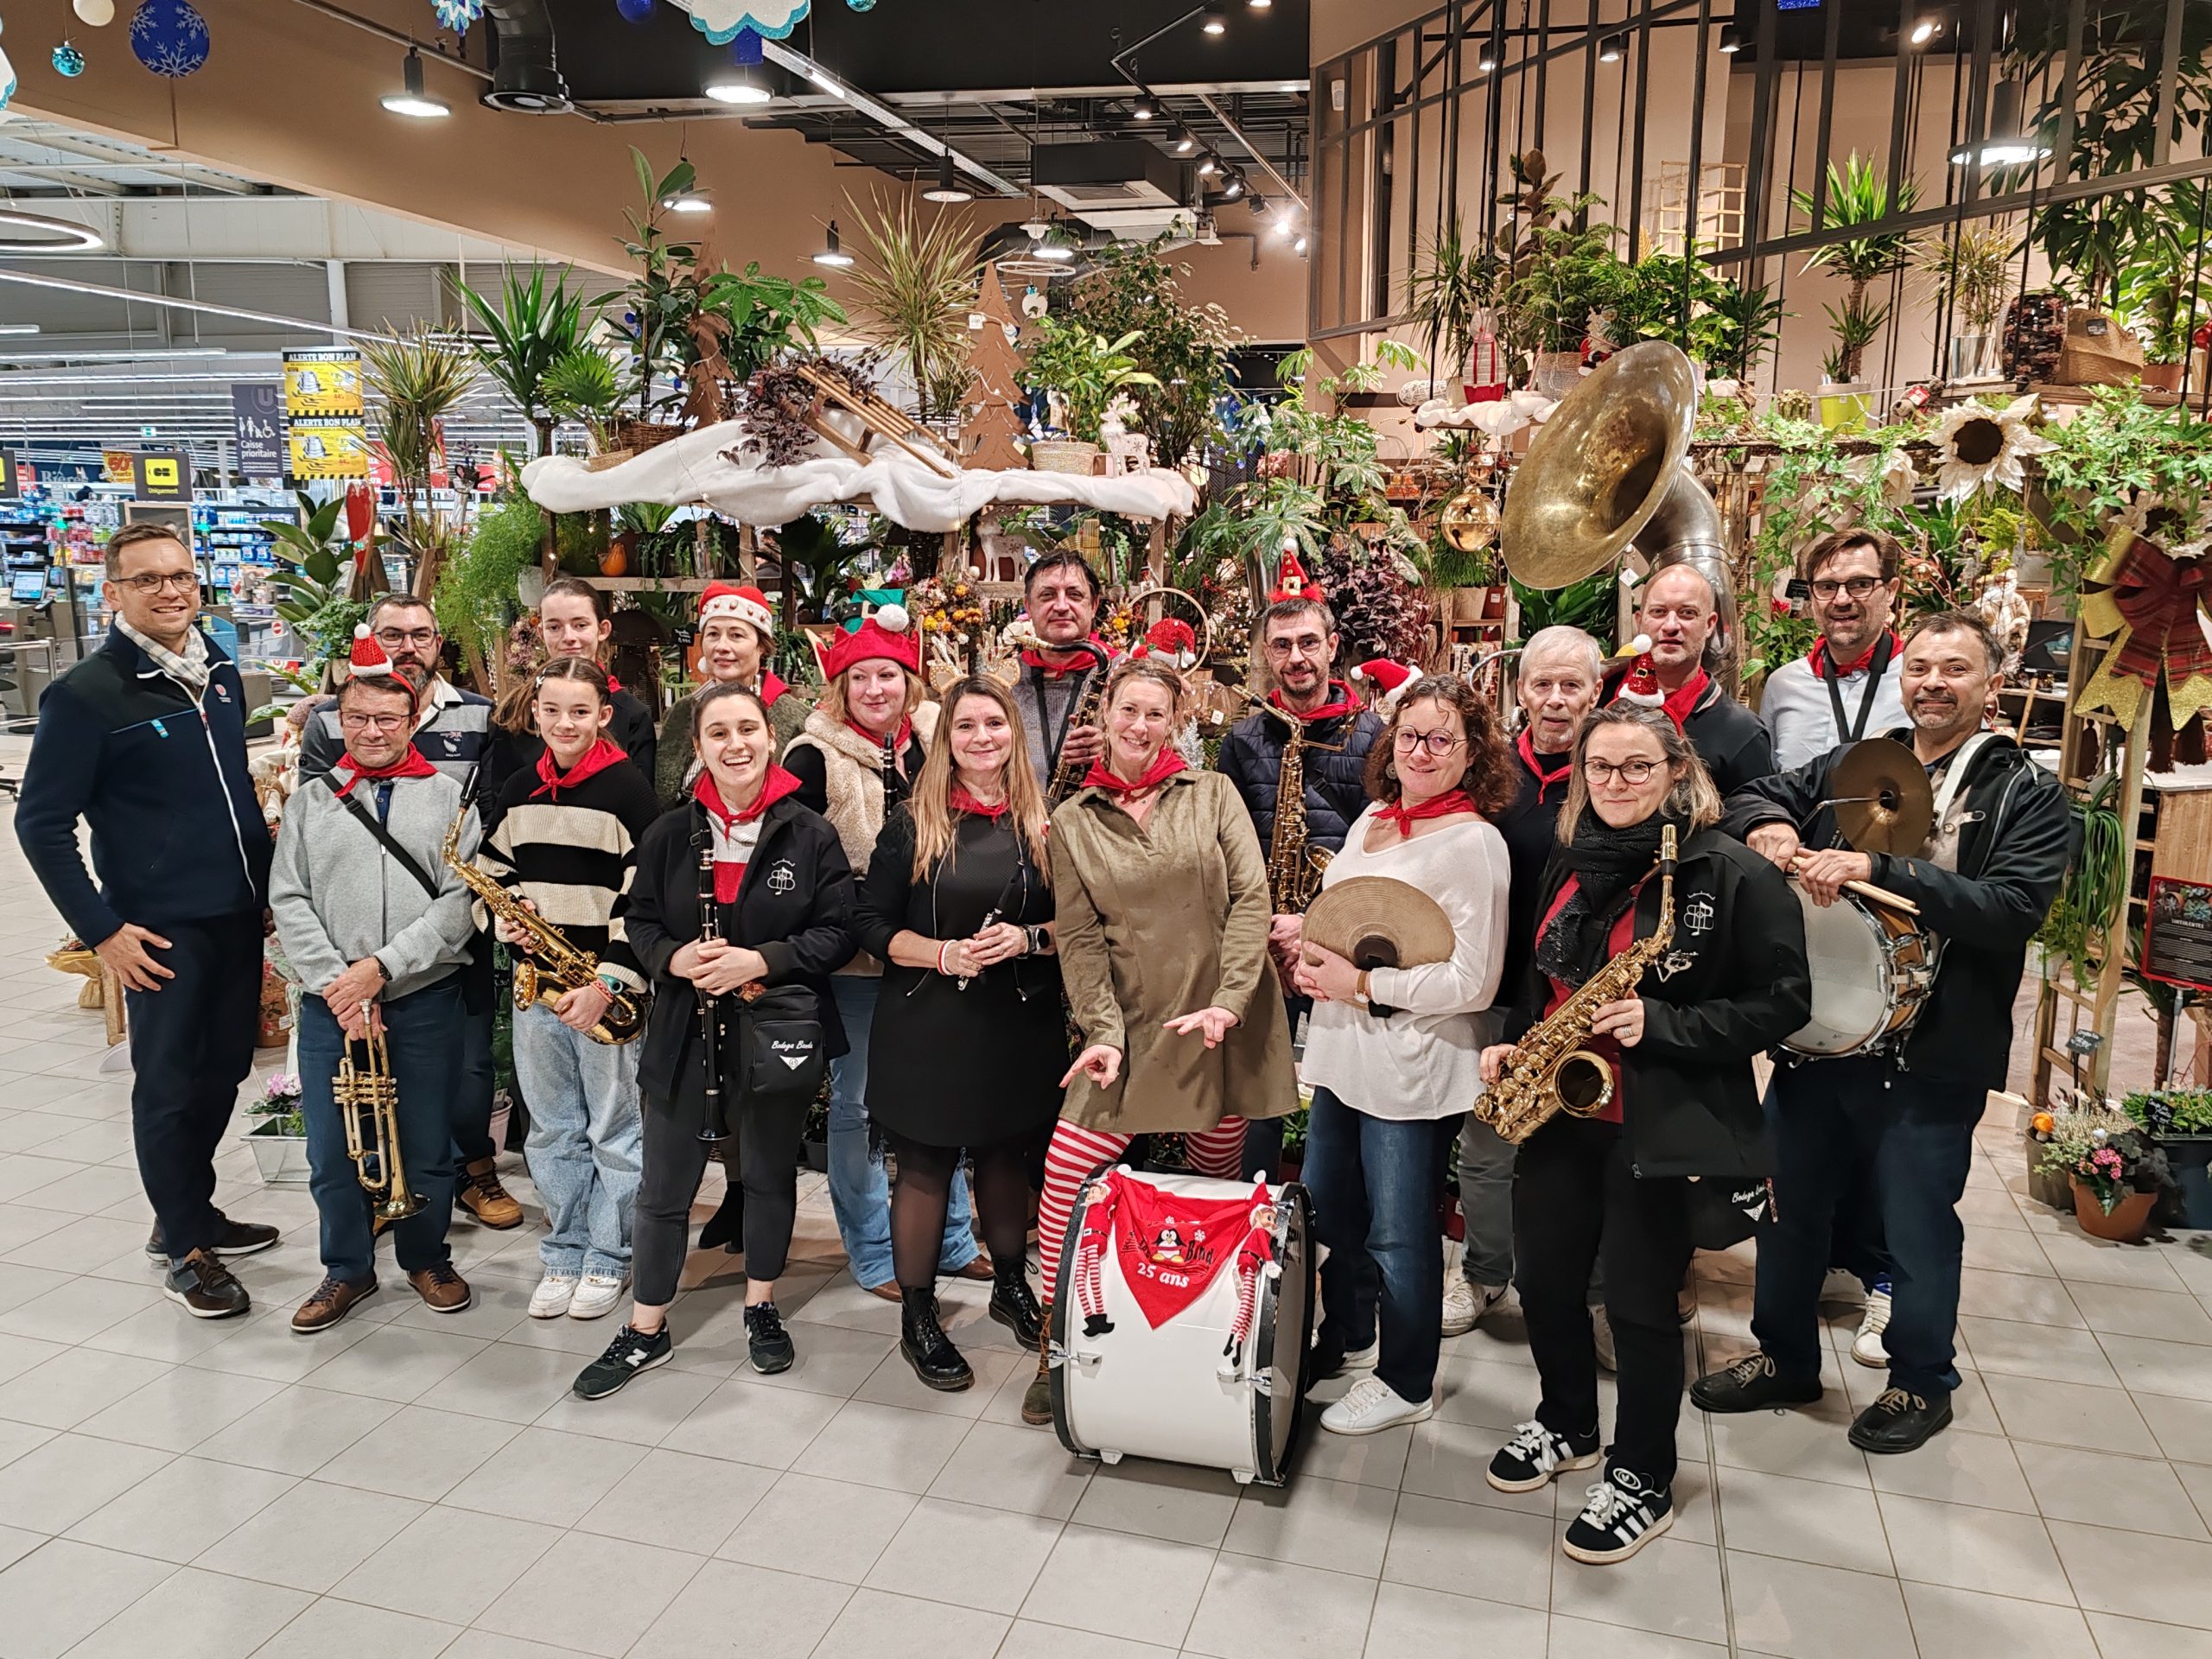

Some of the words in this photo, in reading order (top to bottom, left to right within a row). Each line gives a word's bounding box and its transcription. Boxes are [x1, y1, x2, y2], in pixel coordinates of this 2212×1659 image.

[337, 353, 357, 361] PLAN
[241, 440, 264, 448] Caisse
[241, 448, 277, 459] prioritaire
[772, 1040, 795, 1052] Bodega
[1732, 1191, 1755, 1203] Bodega
[1137, 1262, 1157, 1279] 25
[1159, 1272, 1190, 1288] ans
